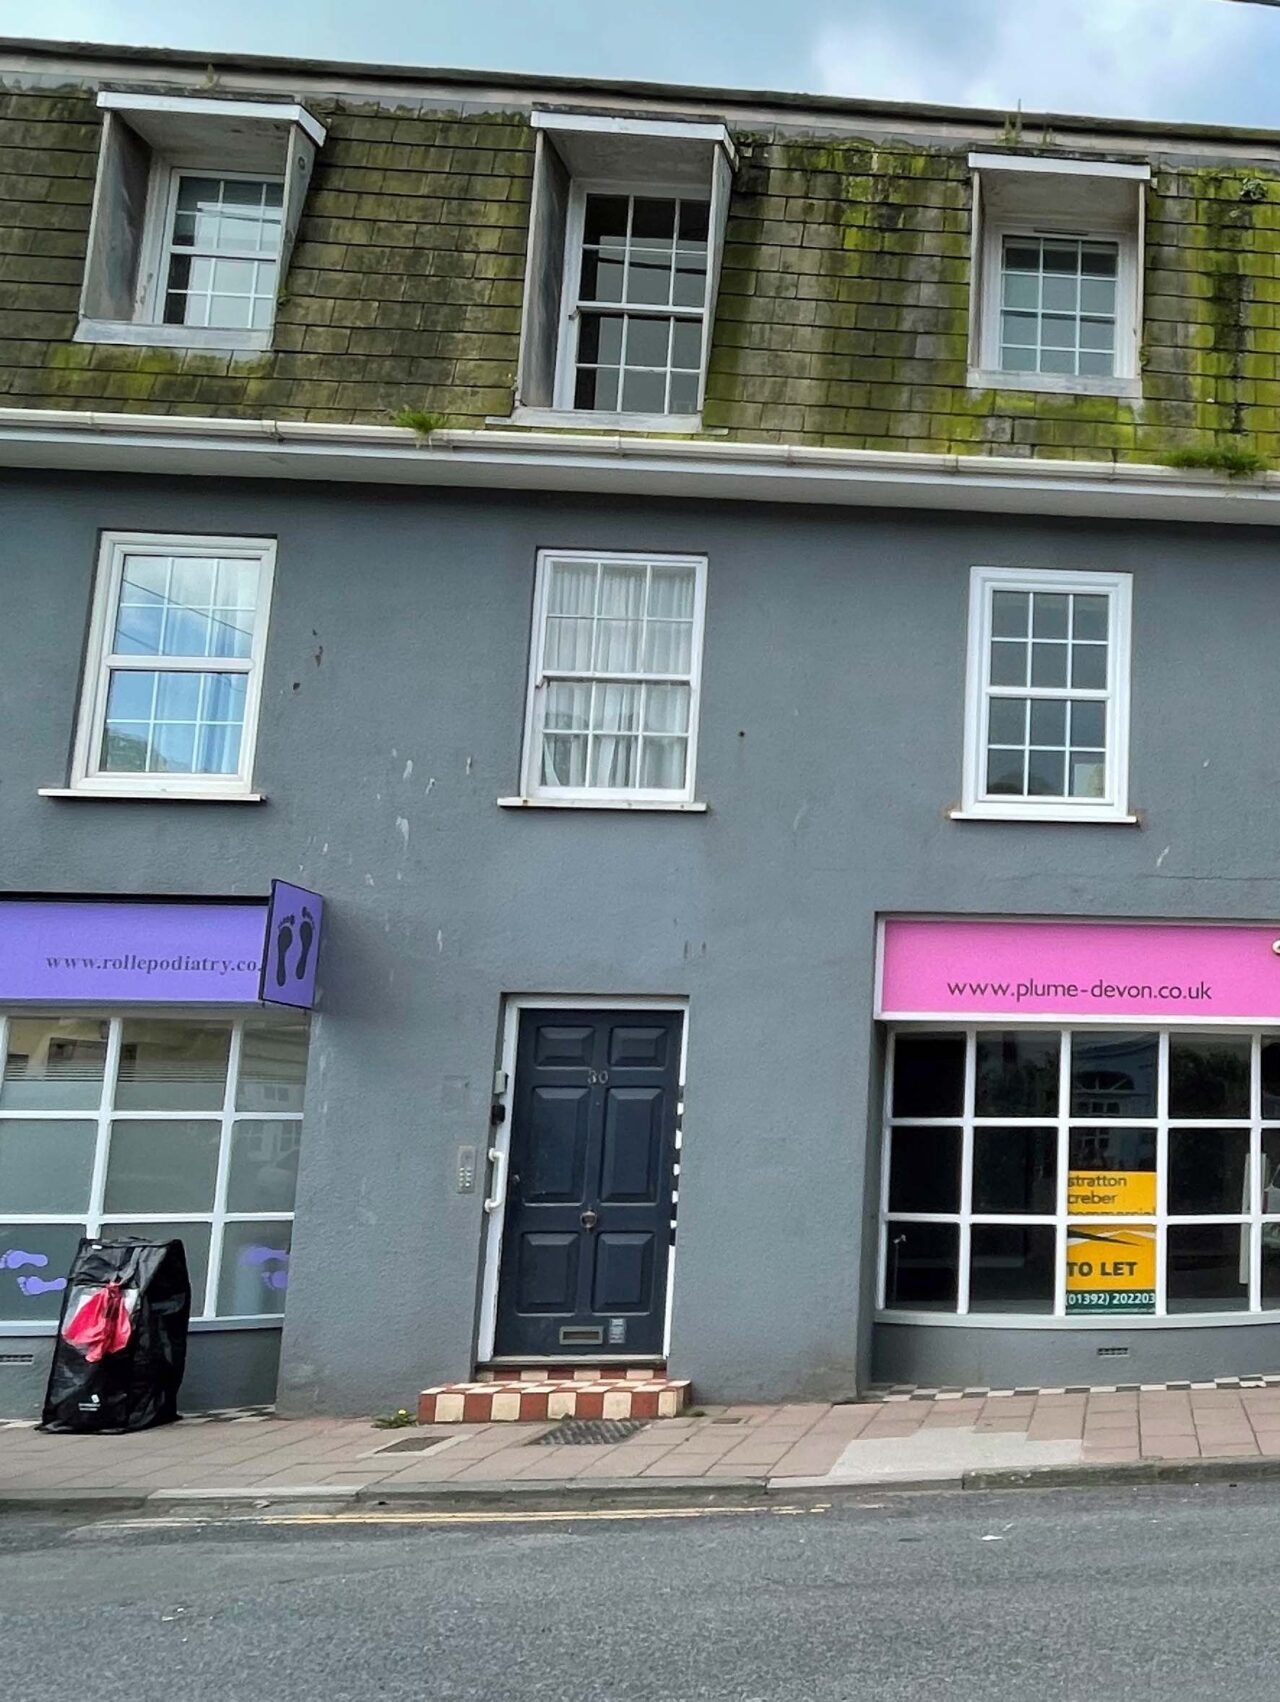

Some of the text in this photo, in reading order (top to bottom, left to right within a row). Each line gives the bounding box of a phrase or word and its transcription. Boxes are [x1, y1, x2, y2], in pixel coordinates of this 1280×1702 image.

[946, 978, 1213, 1003] www.plume-devon.co.uk
[587, 1070, 609, 1085] 30
[1068, 1175, 1127, 1187] stratton
[1068, 1190, 1118, 1204] creber
[1067, 1261, 1138, 1277] TO LET
[1112, 1292, 1155, 1305] 202203
